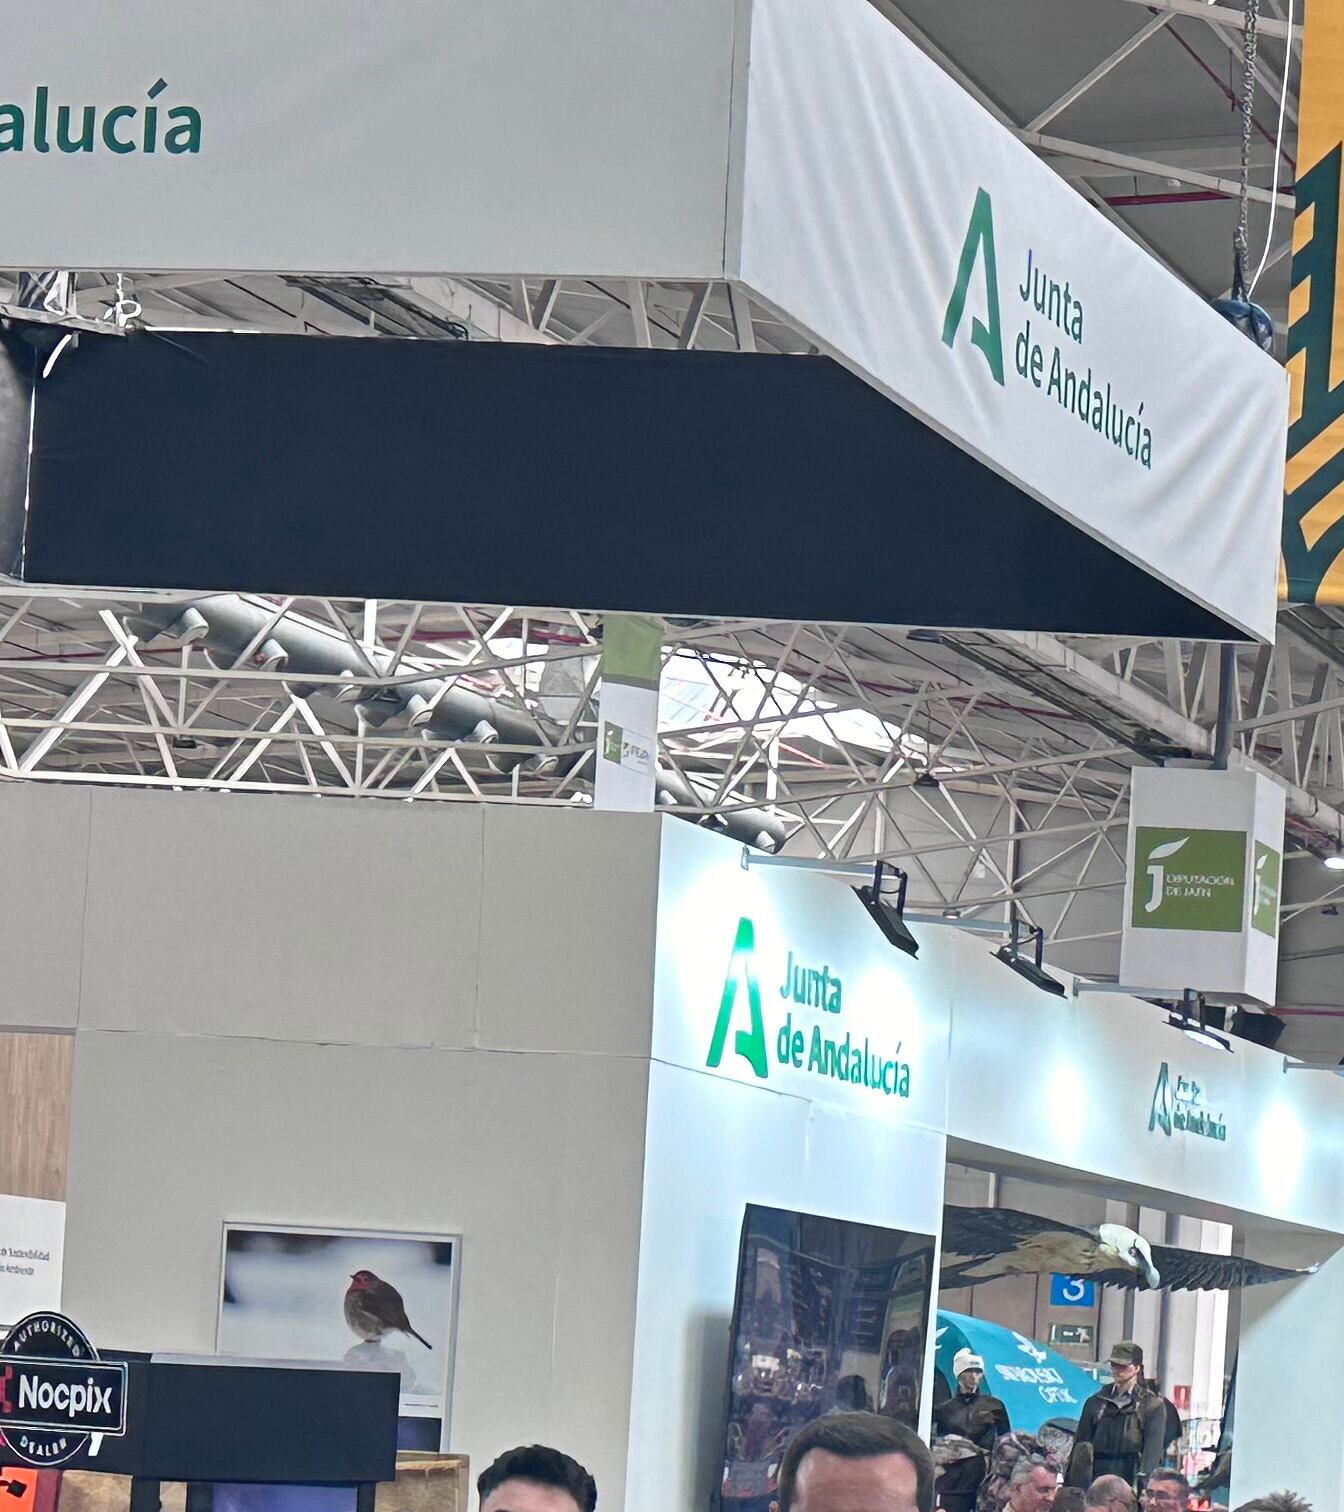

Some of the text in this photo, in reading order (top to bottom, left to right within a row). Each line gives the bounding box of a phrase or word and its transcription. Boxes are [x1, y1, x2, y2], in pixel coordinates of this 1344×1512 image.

[1019, 249, 1083, 344] Junta
[1015, 320, 1152, 470] de Andalucía
[779, 951, 841, 1013] Junta
[777, 1012, 909, 1098] de Andalucía
[18, 1374, 113, 1418] Nocpix
